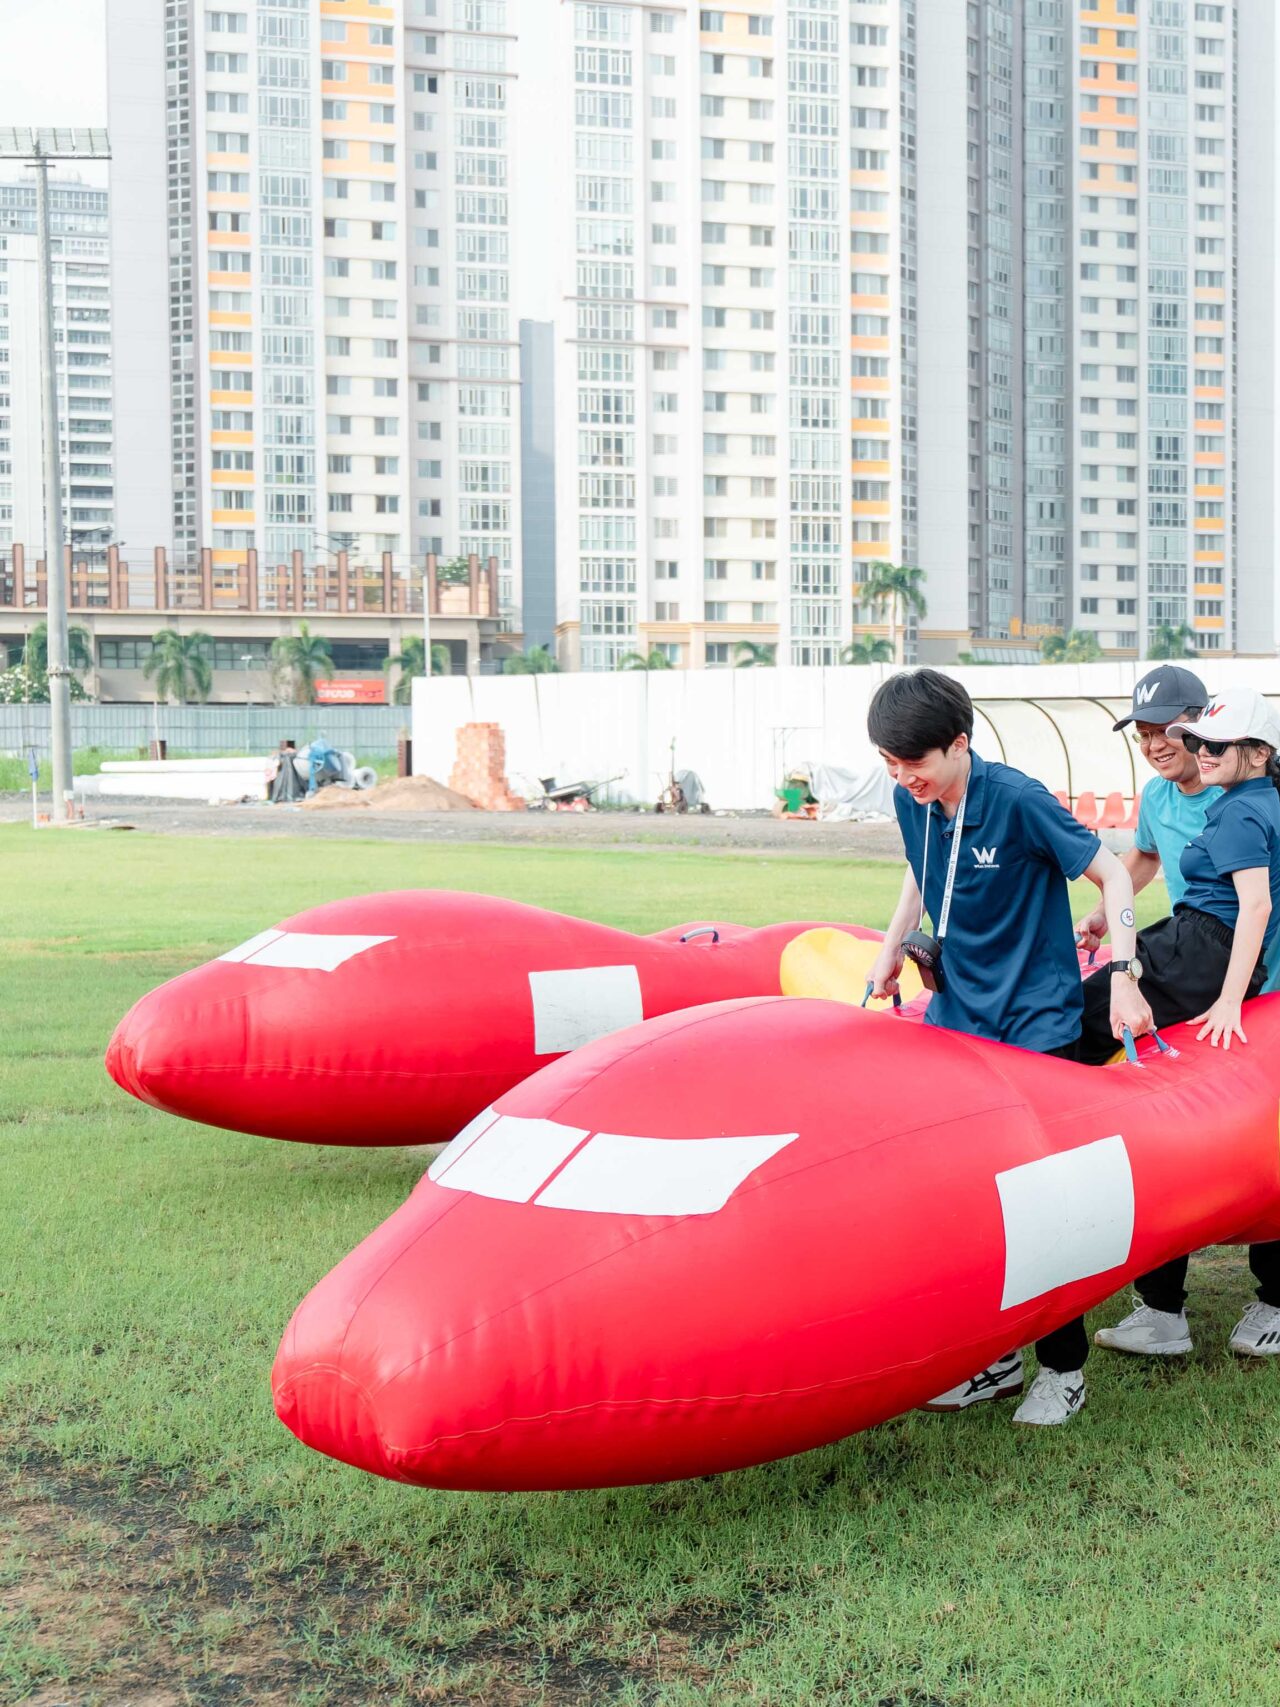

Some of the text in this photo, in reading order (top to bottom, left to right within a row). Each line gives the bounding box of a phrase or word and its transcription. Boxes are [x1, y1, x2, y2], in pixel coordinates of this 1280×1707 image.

[1137, 682, 1160, 705] W
[1204, 703, 1226, 717] W
[971, 846, 997, 864] W
